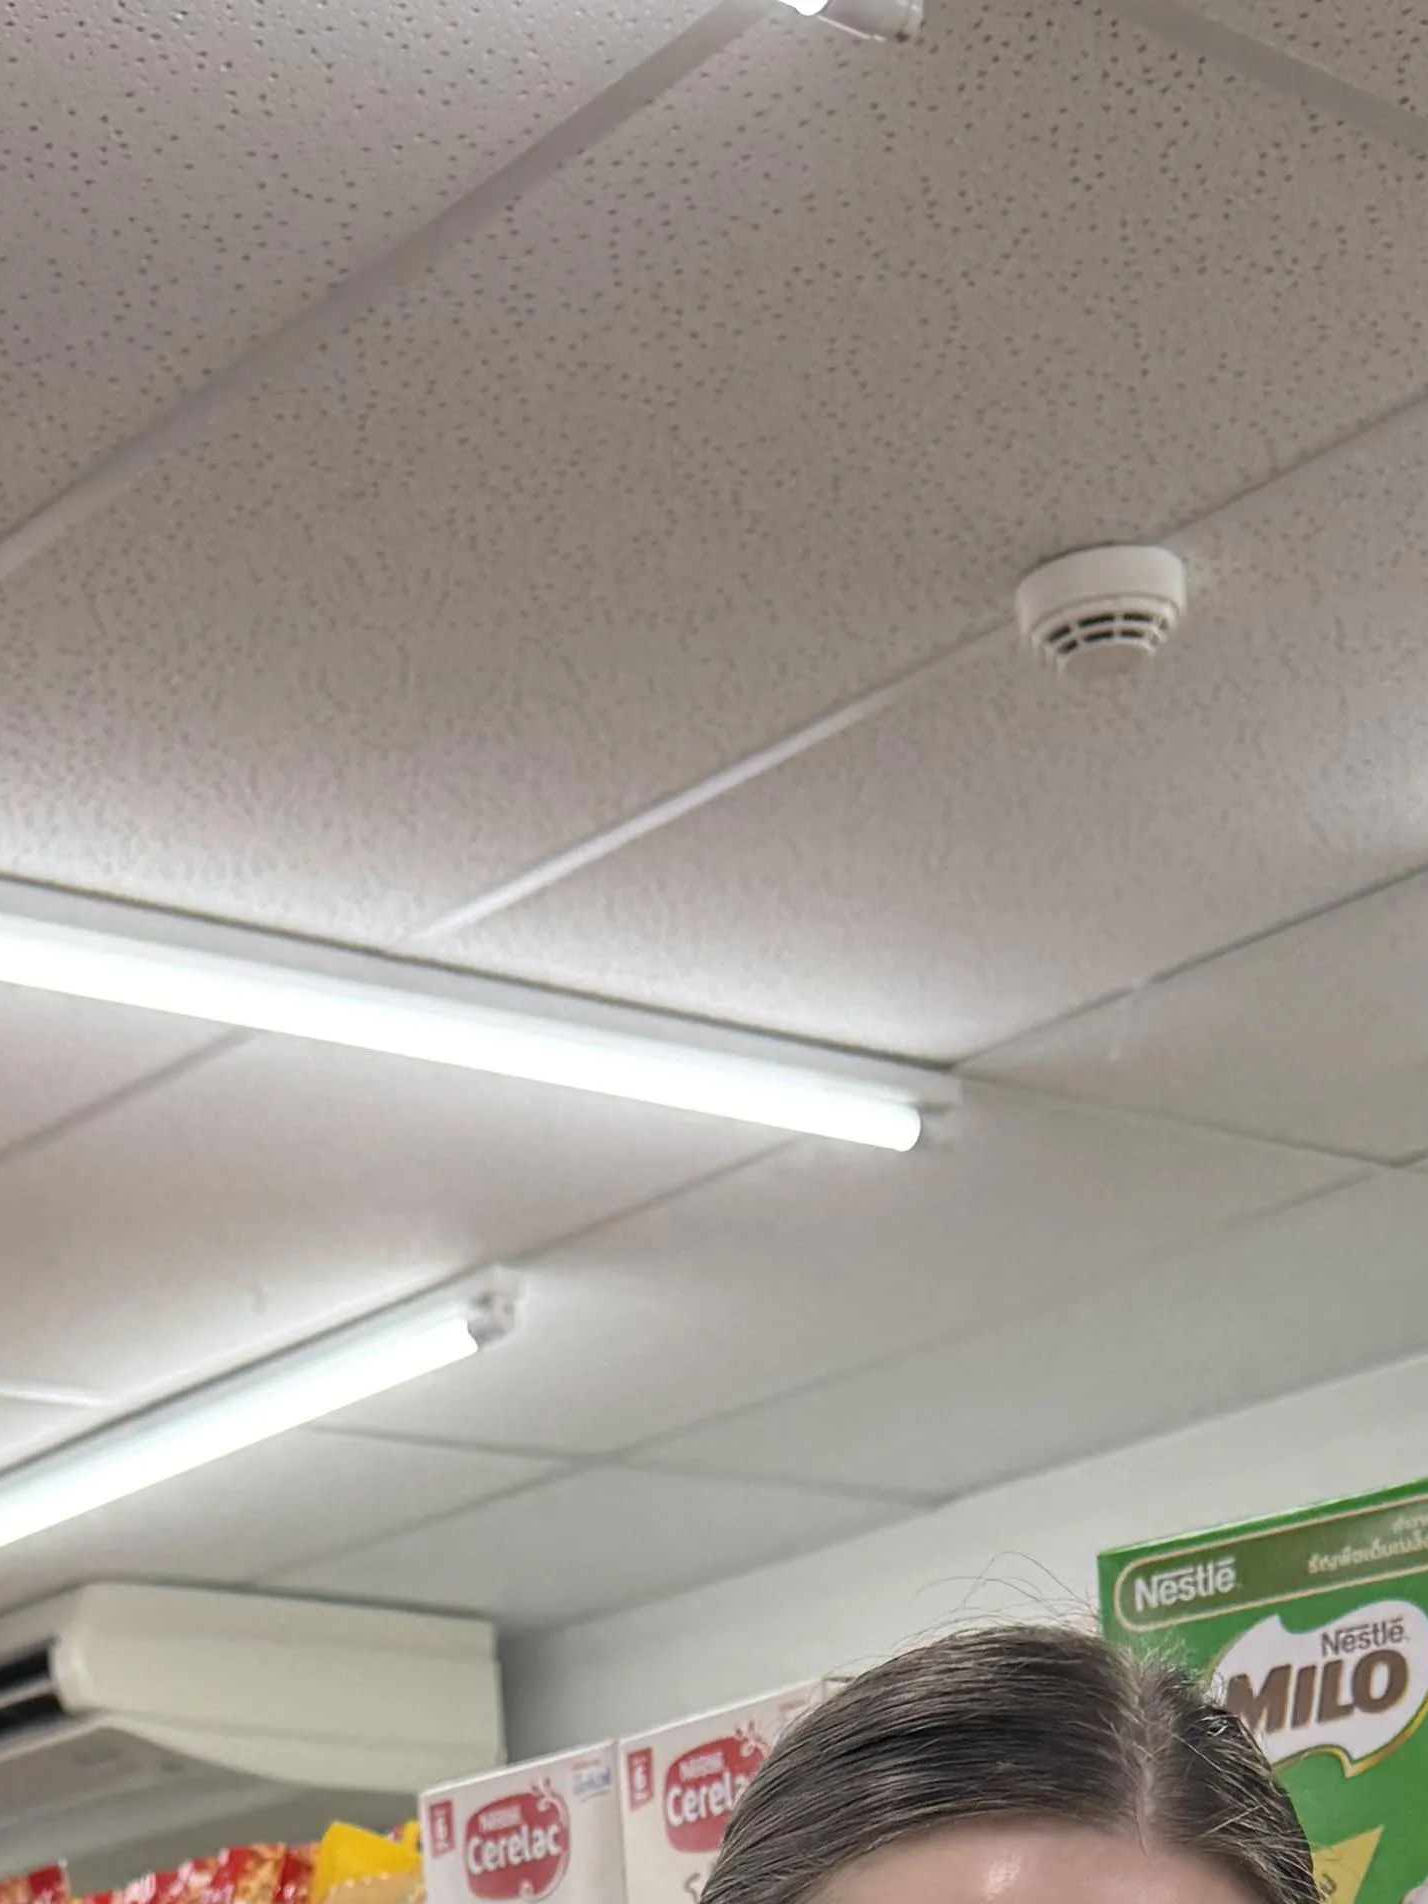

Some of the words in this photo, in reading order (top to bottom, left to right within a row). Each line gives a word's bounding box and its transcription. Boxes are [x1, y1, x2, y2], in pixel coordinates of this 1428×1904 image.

[1224, 1648, 1408, 1736] MILO
[666, 1767, 752, 1828] Cerela
[468, 1823, 561, 1876] Cerelac
